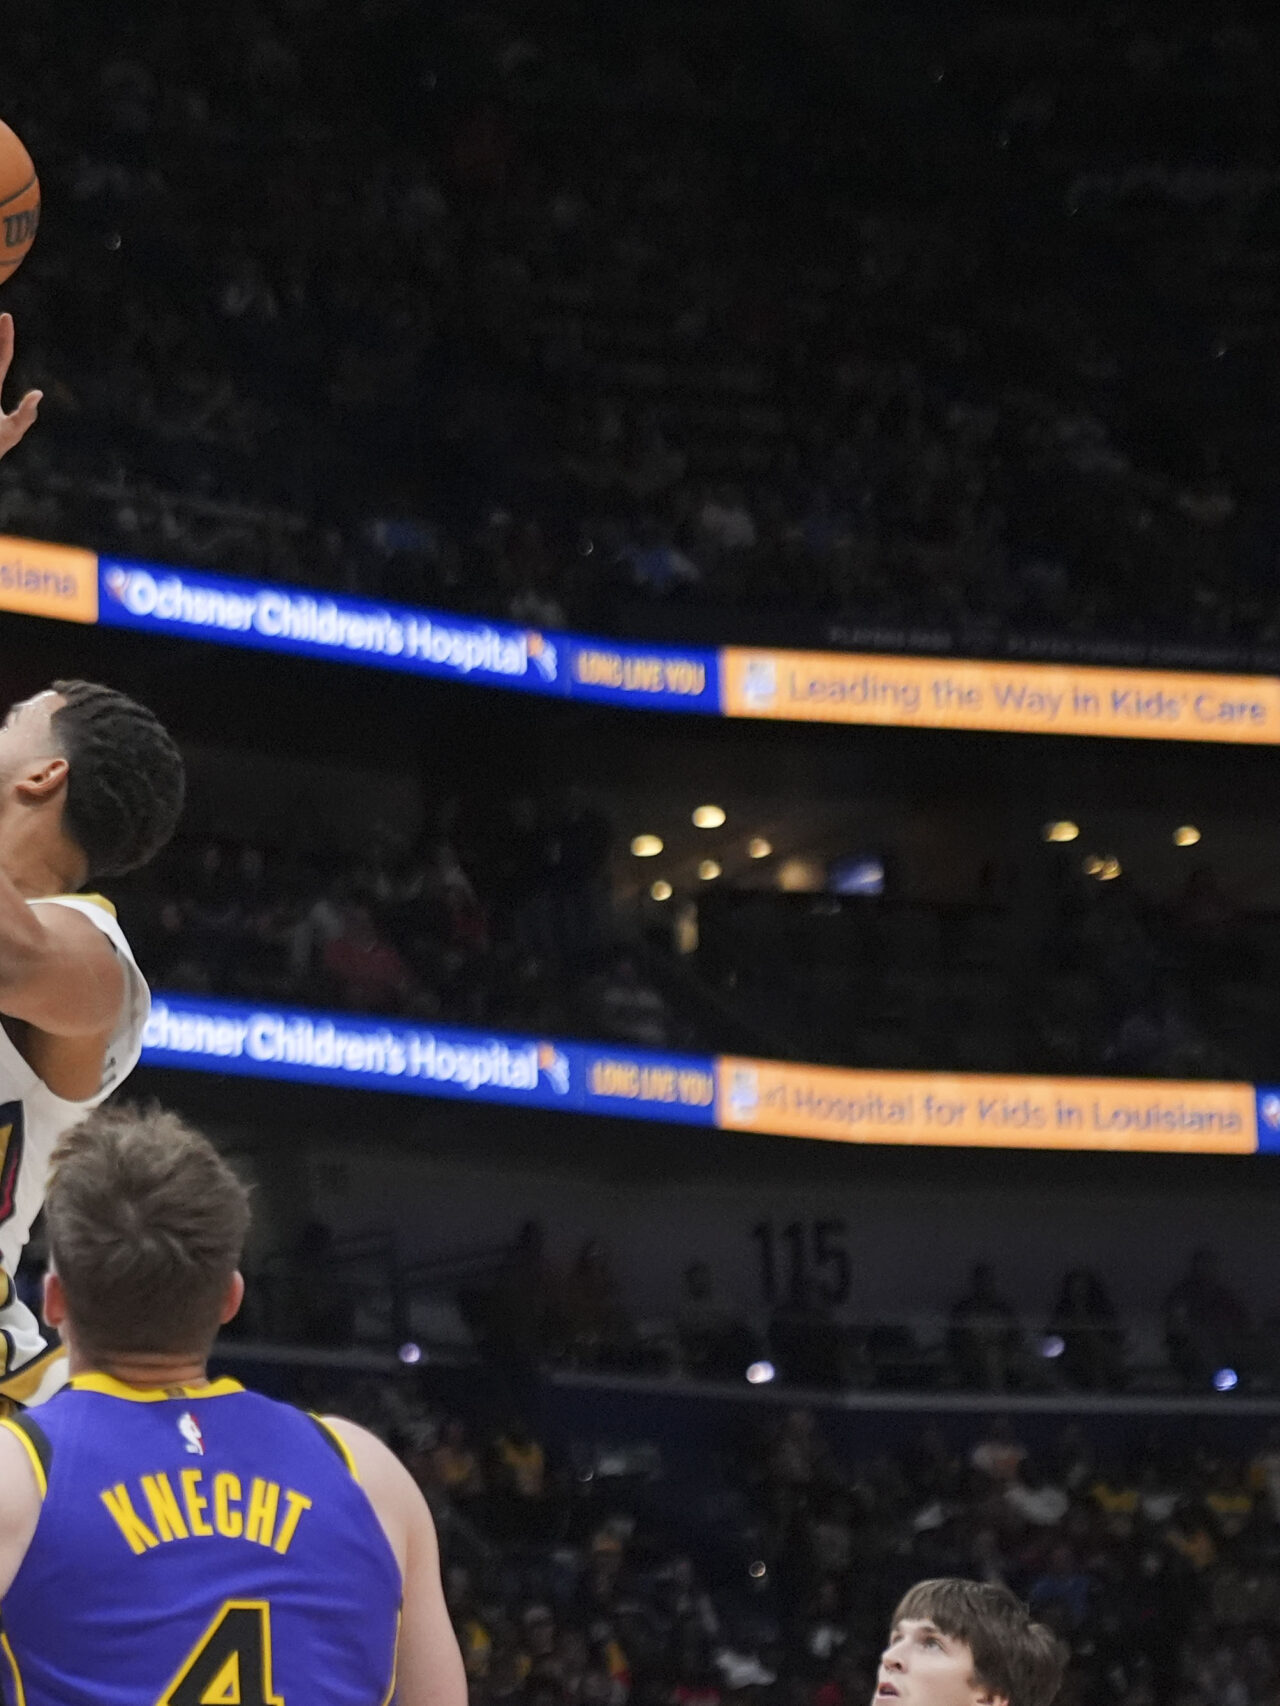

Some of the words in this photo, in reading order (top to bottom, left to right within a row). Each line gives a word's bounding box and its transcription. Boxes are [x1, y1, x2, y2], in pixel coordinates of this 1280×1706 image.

[126, 568, 254, 632] Ochsner
[253, 590, 405, 658] Children's
[406, 616, 528, 676] Hospital
[788, 671, 921, 712] Leading
[932, 679, 984, 711] the
[994, 682, 1063, 721] Way
[1193, 693, 1267, 726] Care
[142, 1003, 246, 1060] chsner
[245, 1012, 407, 1075] Children's
[410, 1035, 538, 1091] Hospital
[794, 1088, 915, 1124] Hospital
[924, 1092, 966, 1126] for
[978, 1098, 1047, 1129] Kids
[1093, 1102, 1242, 1134] Louisiana
[751, 1218, 853, 1302] 115
[101, 1469, 313, 1556] KNECHT
[155, 1599, 285, 1706] 4
